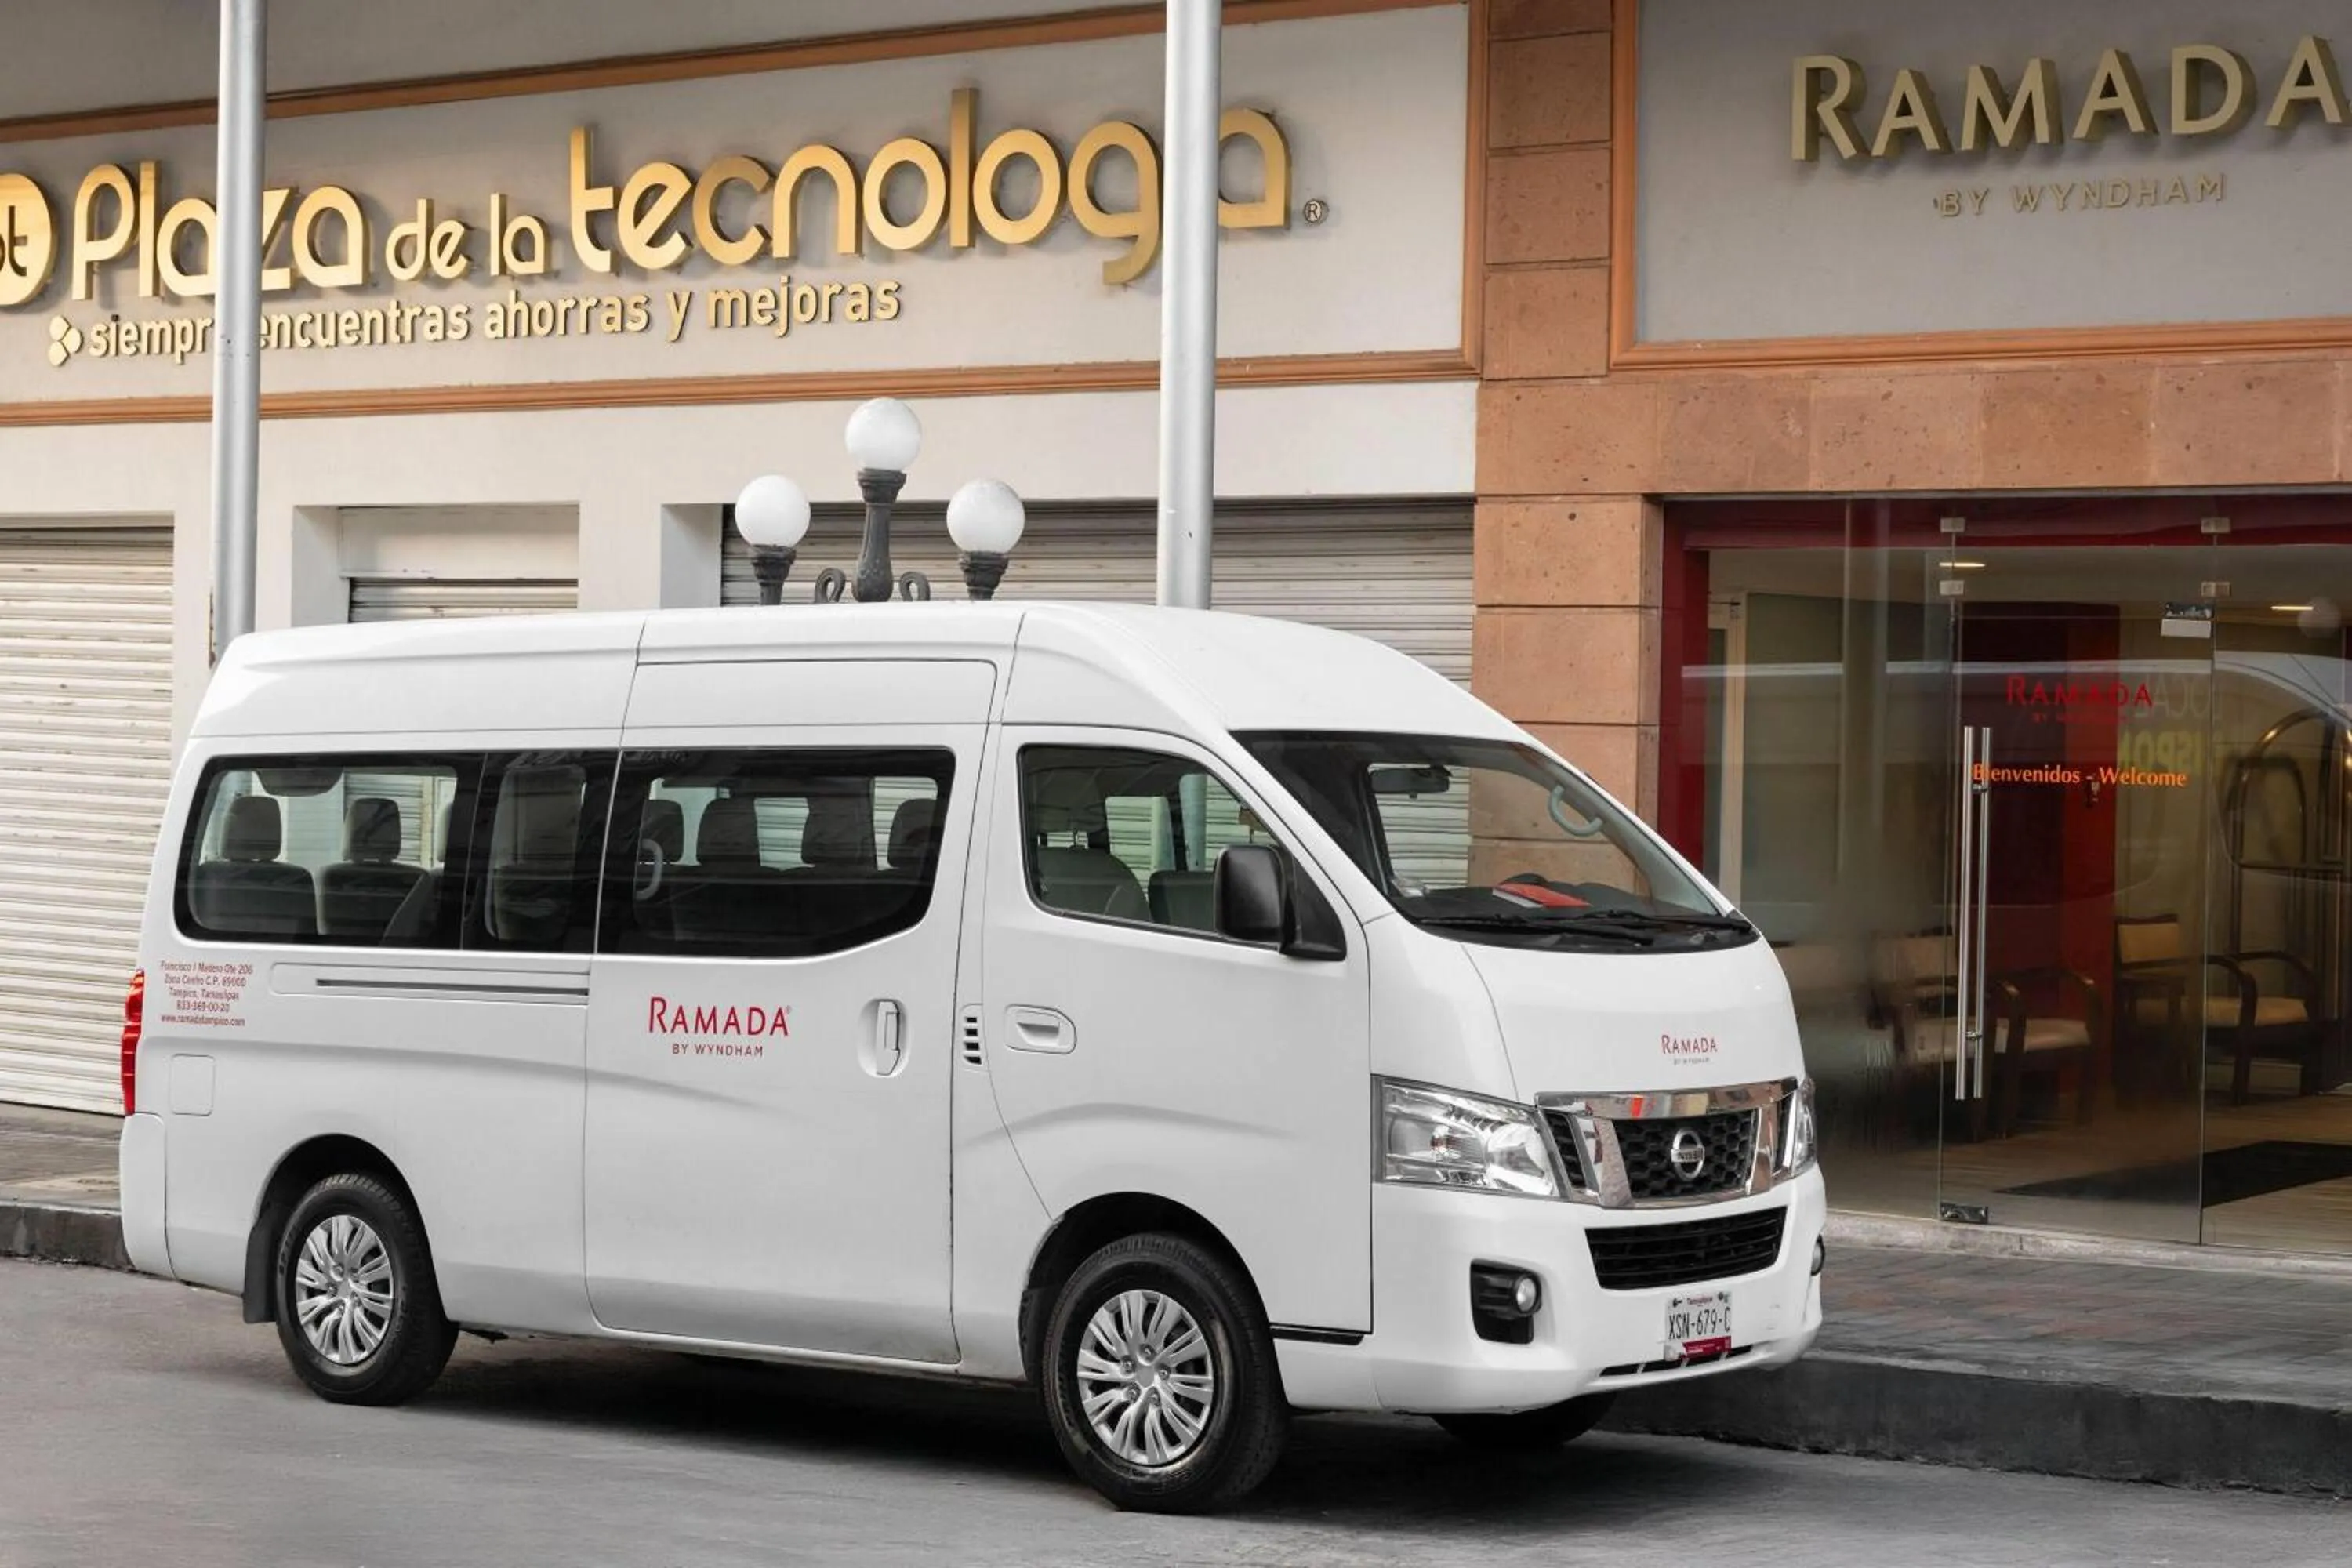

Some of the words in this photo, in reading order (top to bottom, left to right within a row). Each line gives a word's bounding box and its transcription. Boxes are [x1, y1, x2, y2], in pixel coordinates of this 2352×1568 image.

[1791, 35, 2351, 161] RAMADA
[385, 198, 473, 281] de
[490, 193, 552, 277] la
[570, 87, 1292, 285] tecnologa
[1936, 188, 1989, 218] BY
[2009, 172, 2227, 213] WYNDHAM
[89, 314, 214, 366] siempr
[485, 289, 651, 340] ahorras
[666, 291, 693, 343] y
[706, 274, 902, 339] mejoras
[1973, 763, 2080, 784] Bienvenidos
[2100, 767, 2187, 787] Welcome
[648, 996, 789, 1036] RAMADA
[672, 1044, 688, 1054] BY
[695, 1044, 764, 1058] WYNDHAM
[1661, 1034, 1718, 1054] RAMADA
